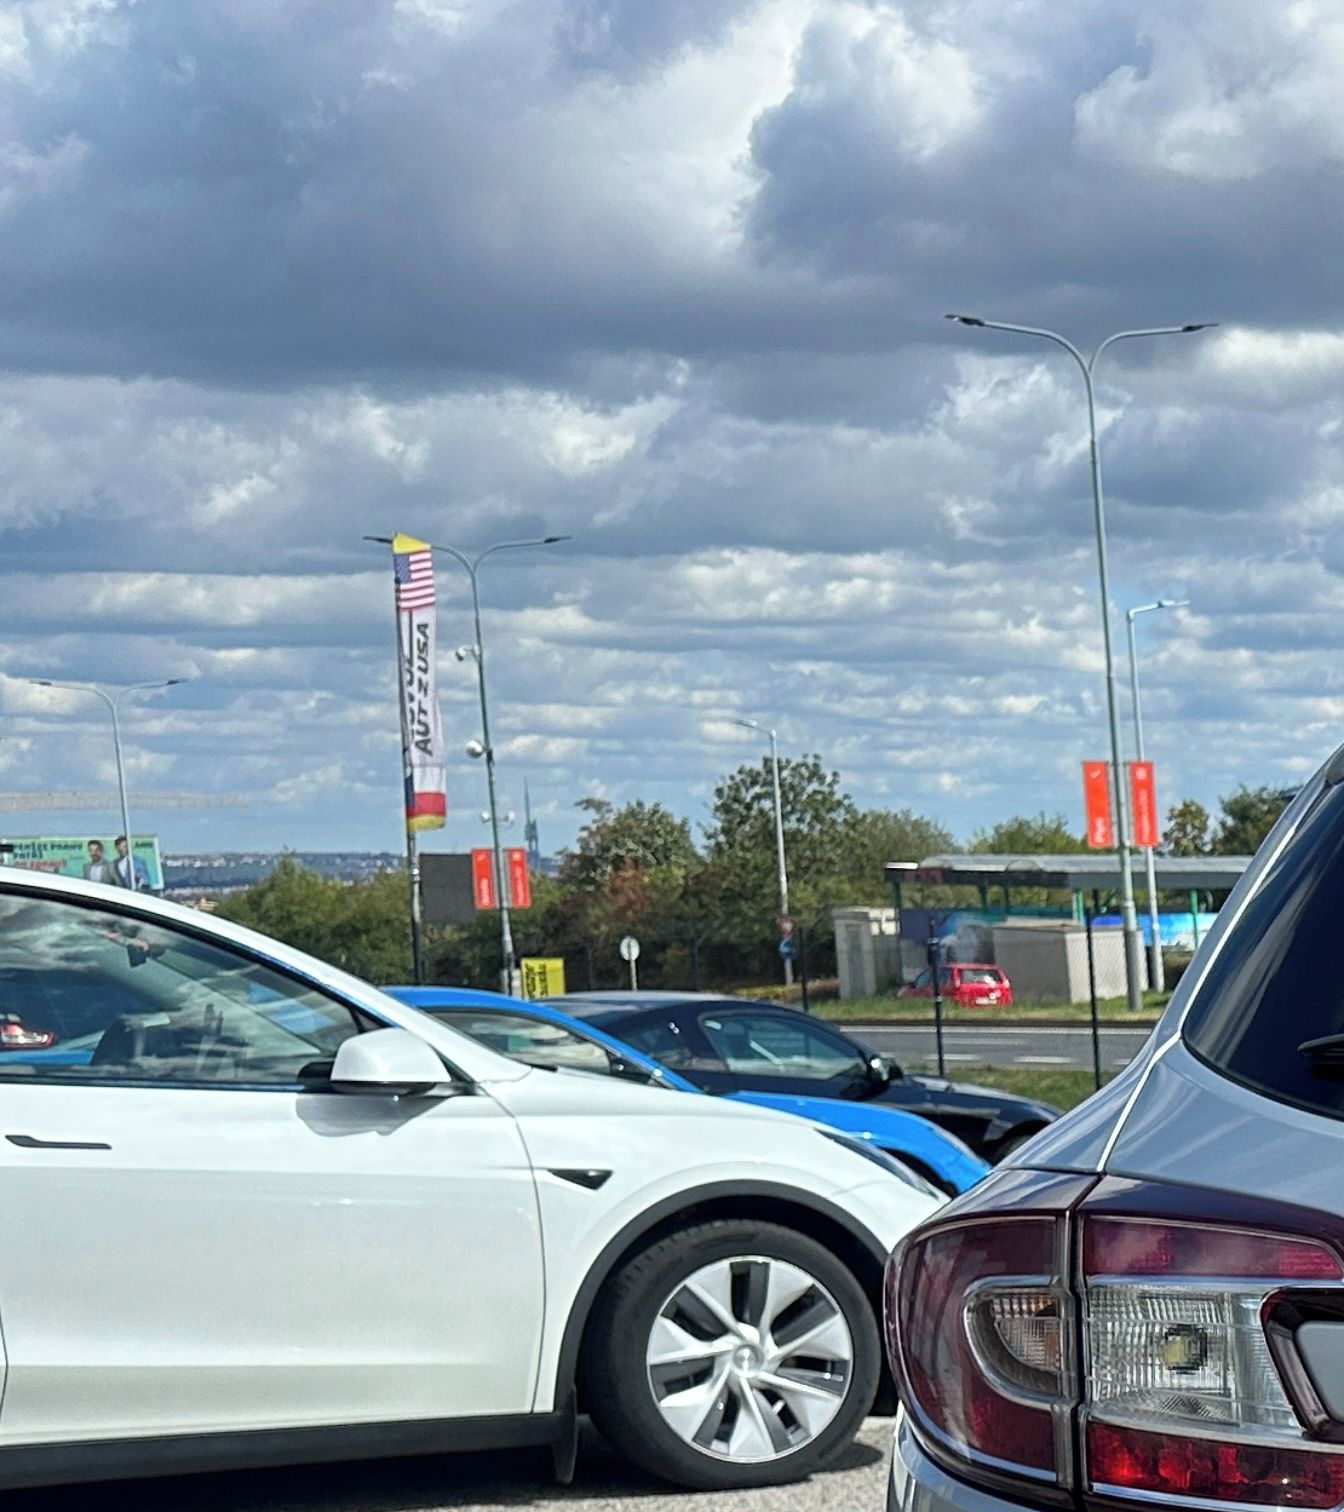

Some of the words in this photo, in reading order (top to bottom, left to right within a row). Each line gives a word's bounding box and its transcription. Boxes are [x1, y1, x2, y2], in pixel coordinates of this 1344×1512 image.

[416, 623, 430, 675] USA
[418, 677, 429, 698] Z
[414, 700, 433, 757] AUT
